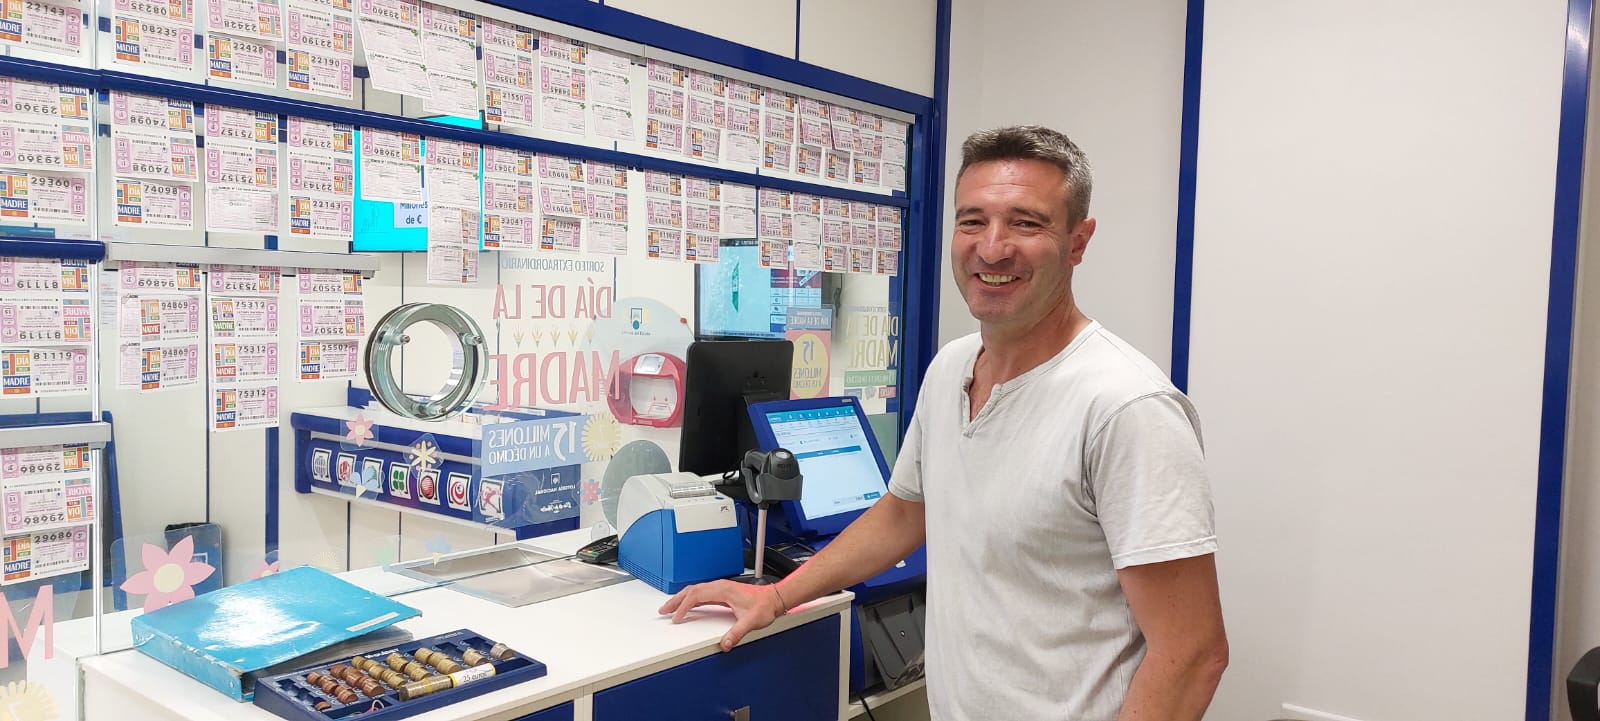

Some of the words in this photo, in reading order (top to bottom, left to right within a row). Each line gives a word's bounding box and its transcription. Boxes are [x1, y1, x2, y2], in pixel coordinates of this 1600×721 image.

[26, 2, 65, 16] 22143
[131, 2, 167, 16] 08235
[372, 7, 399, 20] 29360
[142, 24, 178, 36] 08235
[224, 20, 257, 32] 22428
[302, 36, 332, 48] 22190
[116, 42, 140, 54] MADRE
[233, 42, 264, 54] 22428
[312, 56, 340, 67] 22190
[502, 92, 524, 102] 21550
[15, 104, 58, 114] 29360
[130, 115, 166, 127] 74098
[221, 128, 252, 138] 75157
[302, 138, 332, 149] 22143
[374, 148, 400, 158] 29686
[18, 154, 60, 165] 29360
[132, 164, 169, 174] 74098
[31, 176, 70, 188] 29360
[221, 174, 253, 184] 75157
[144, 184, 178, 195] 74098
[303, 180, 332, 190] 22143
[0, 198, 27, 209] MADRE
[313, 200, 340, 209] 22143
[118, 204, 141, 216] MADRE
[406, 215, 415, 224] de
[417, 214, 422, 224] €
[17, 280, 58, 288] 81119
[138, 279, 174, 288] 94869
[226, 281, 256, 290] 75312
[162, 301, 188, 310] 94869
[236, 301, 265, 310] 75312
[315, 326, 344, 335] 25507
[20, 332, 60, 340] 81119
[162, 349, 188, 357] 94869
[238, 346, 266, 354] 75312
[322, 344, 348, 352] 25507
[34, 352, 72, 360] 81119
[3, 376, 30, 386] MADRE
[238, 389, 266, 398] 75312
[20, 464, 60, 474] 29686
[24, 514, 64, 524] 29686
[34, 531, 72, 544] 29686
[4, 560, 30, 572] MADRE
[463, 673, 471, 682] 25
